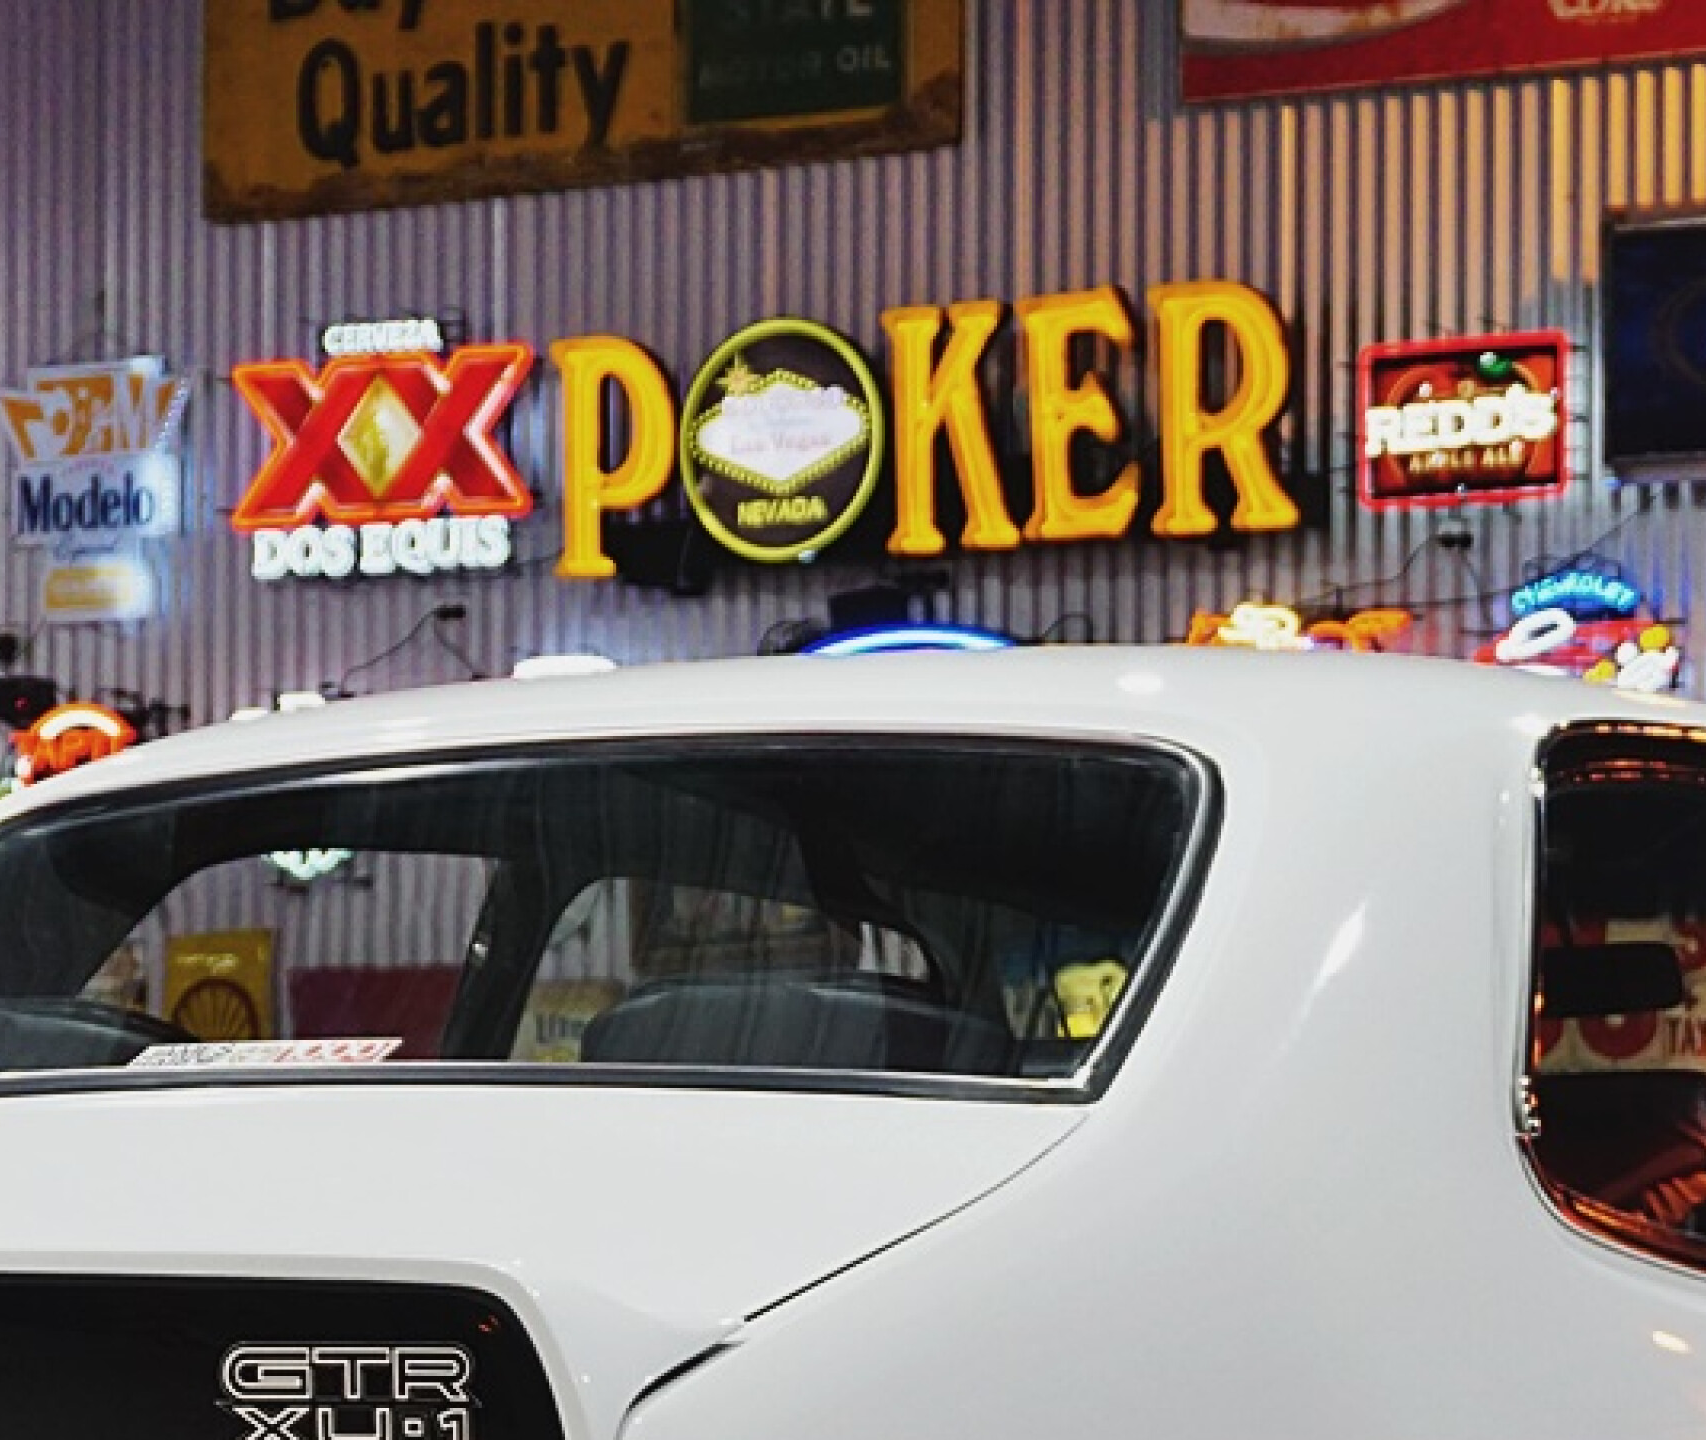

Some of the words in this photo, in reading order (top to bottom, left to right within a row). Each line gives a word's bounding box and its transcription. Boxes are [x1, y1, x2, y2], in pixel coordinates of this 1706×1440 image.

[836, 45, 891, 73] OIL
[297, 21, 630, 168] Quality
[232, 342, 534, 535] XX
[549, 280, 1299, 578] POKER
[1364, 384, 1558, 458] REDD'S
[17, 470, 154, 535] Modelo
[737, 496, 829, 528] NEVADA
[252, 524, 356, 580] DOS
[359, 514, 512, 575] EQUIS
[221, 1345, 471, 1401] GTR
